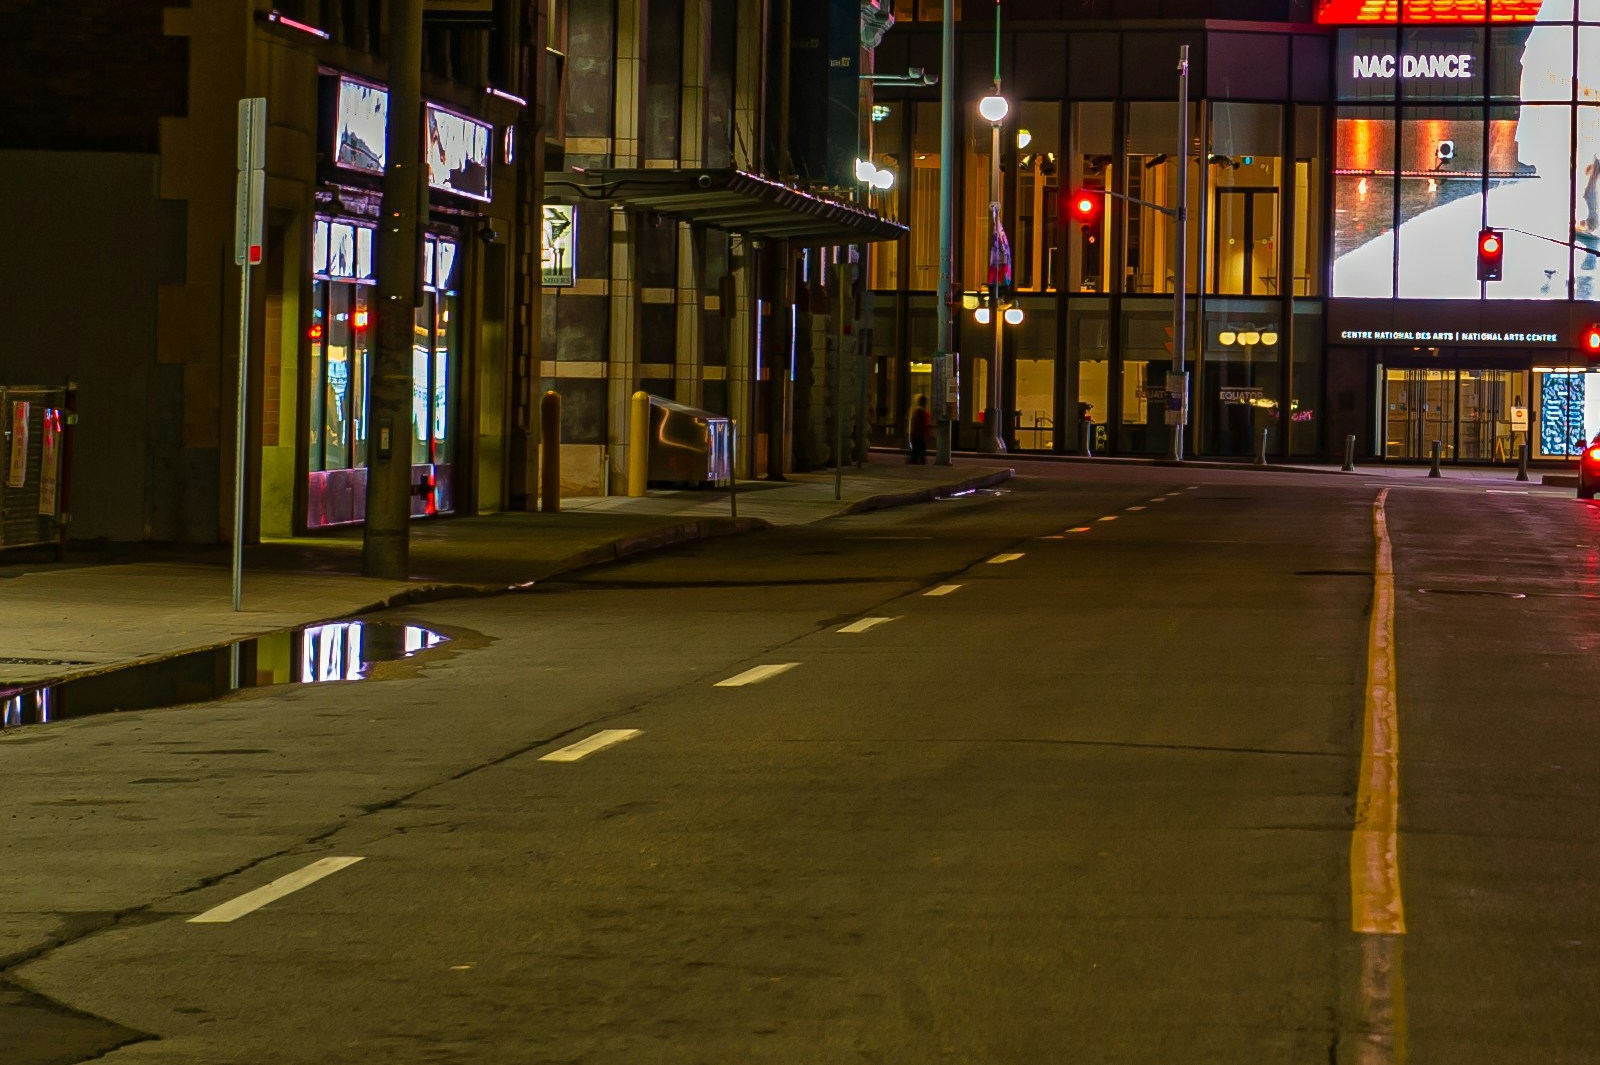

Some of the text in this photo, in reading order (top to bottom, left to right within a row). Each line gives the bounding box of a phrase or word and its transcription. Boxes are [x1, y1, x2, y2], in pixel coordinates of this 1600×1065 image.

[1353, 55, 1472, 78] NAC DANCE
[1341, 331, 1558, 342] CENTRE NATIONAL DES ARTS NATIONAL ARTS CENTRE
[1219, 391, 1263, 400] EQUATOR
